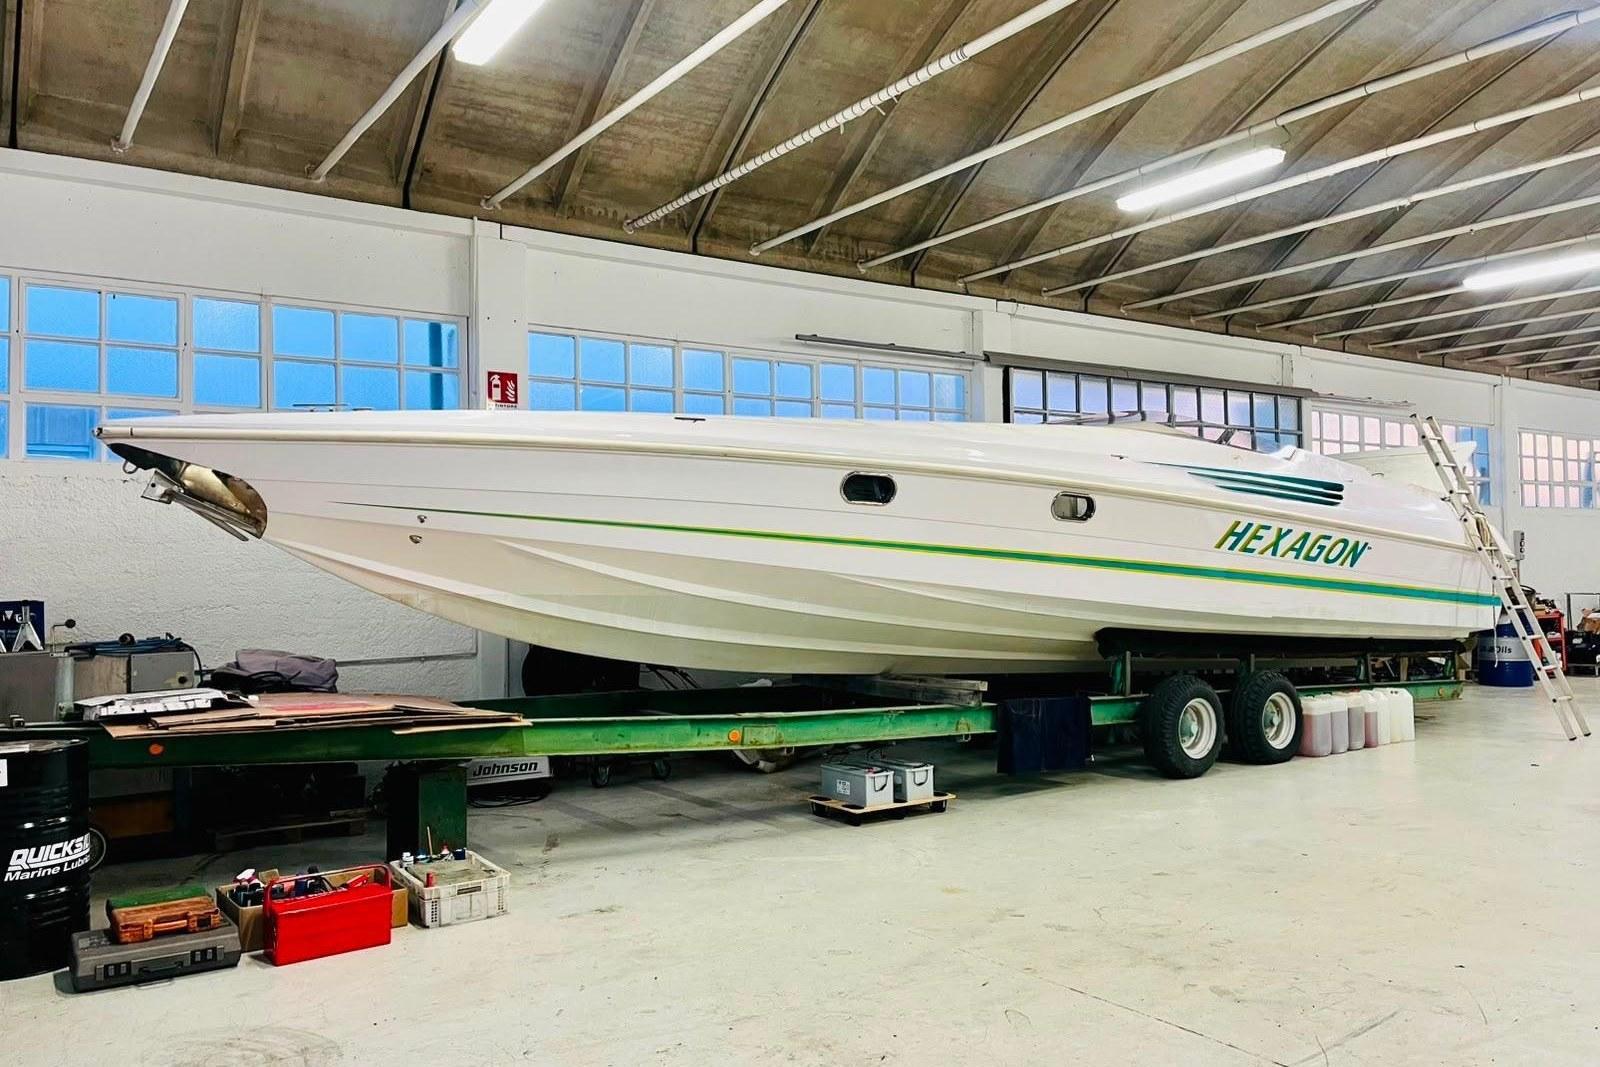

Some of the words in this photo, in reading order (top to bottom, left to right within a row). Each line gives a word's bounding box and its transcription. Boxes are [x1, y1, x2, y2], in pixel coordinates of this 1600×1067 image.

[1214, 520, 1369, 568] HEXAGON
[473, 761, 538, 777] Johnson
[4, 866, 61, 882] Marine
